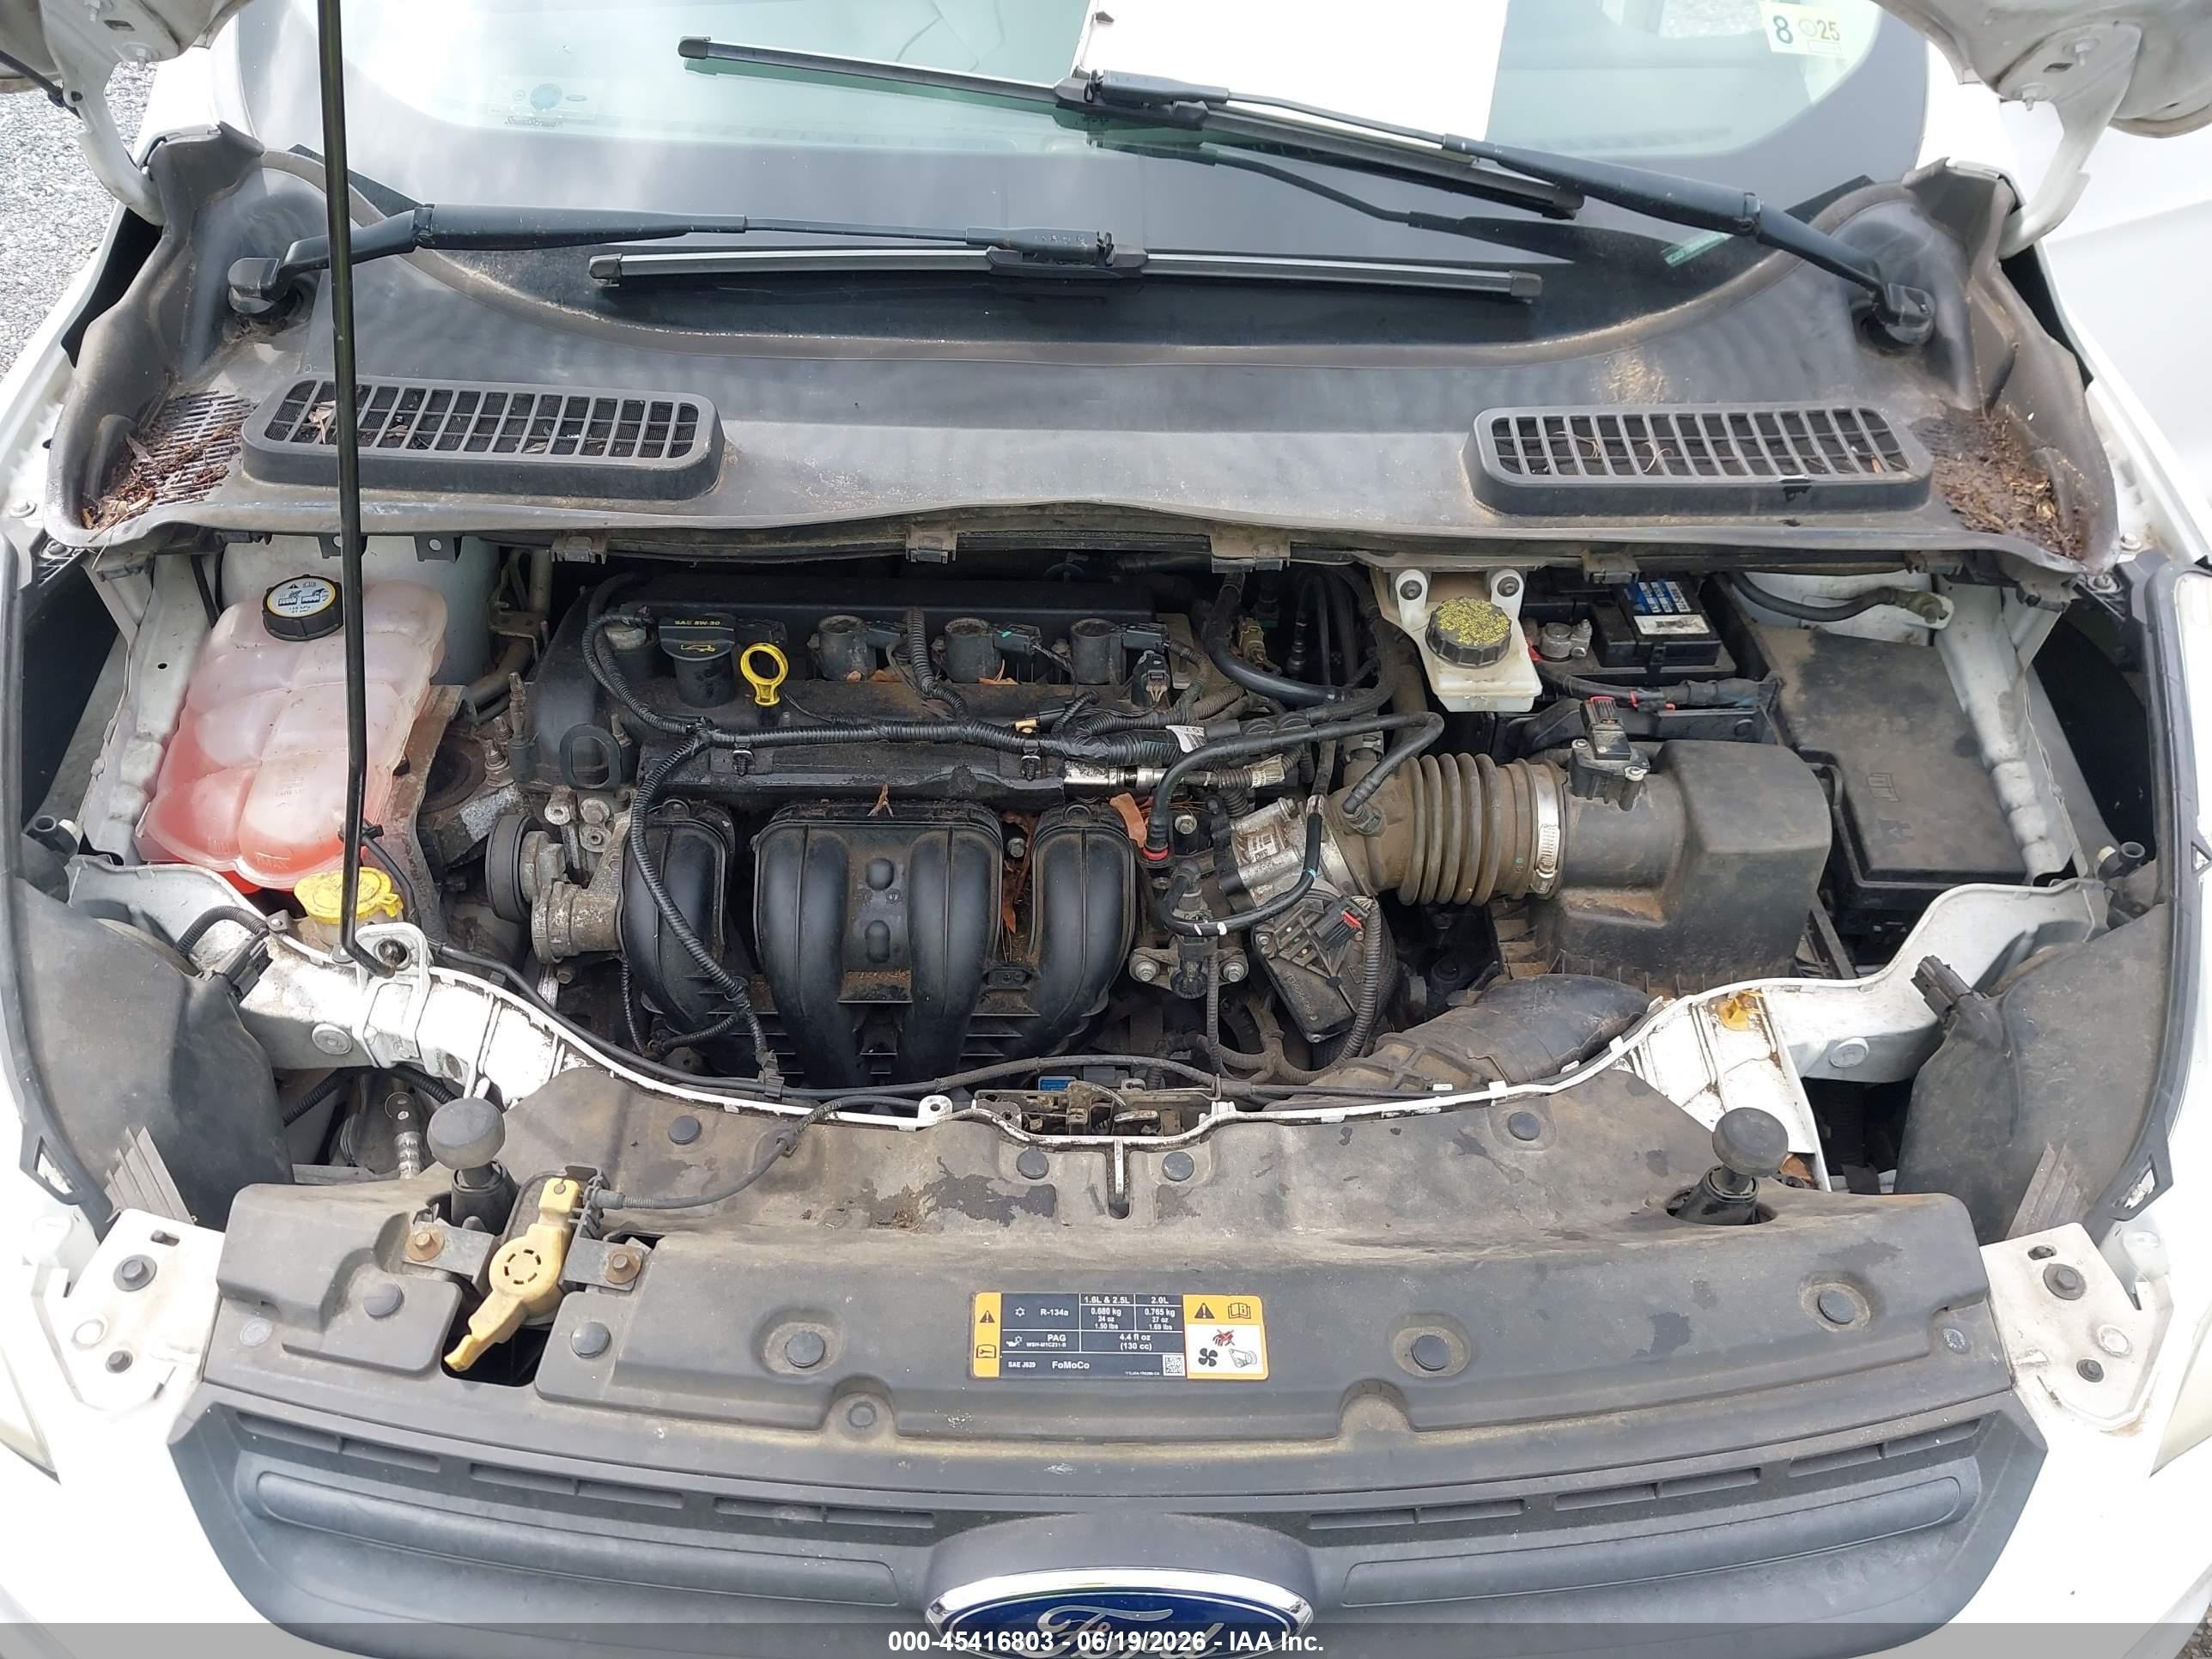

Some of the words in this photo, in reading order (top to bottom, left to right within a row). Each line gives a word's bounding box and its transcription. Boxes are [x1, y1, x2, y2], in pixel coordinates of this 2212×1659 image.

[1772, 15, 1794, 45] 8
[1816, 19, 1841, 42] 25
[1084, 1296, 1103, 1304] 1.6L
[1103, 1296, 1110, 1304] &
[1112, 1296, 1131, 1304] 2.5L
[1151, 1296, 1170, 1304] 2.0L
[1040, 1308, 1069, 1316] R-134a
[1112, 1307, 1122, 1317] kg
[1165, 1308, 1176, 1317] kg
[1047, 1334, 1066, 1342] PAG
[1119, 1333, 1132, 1341] 4.4
[1133, 1333, 1139, 1341] fl
[1120, 1341, 1138, 1352] (130
[1139, 1341, 1152, 1352] cc)
[1051, 1360, 1091, 1370] FoMoCo
